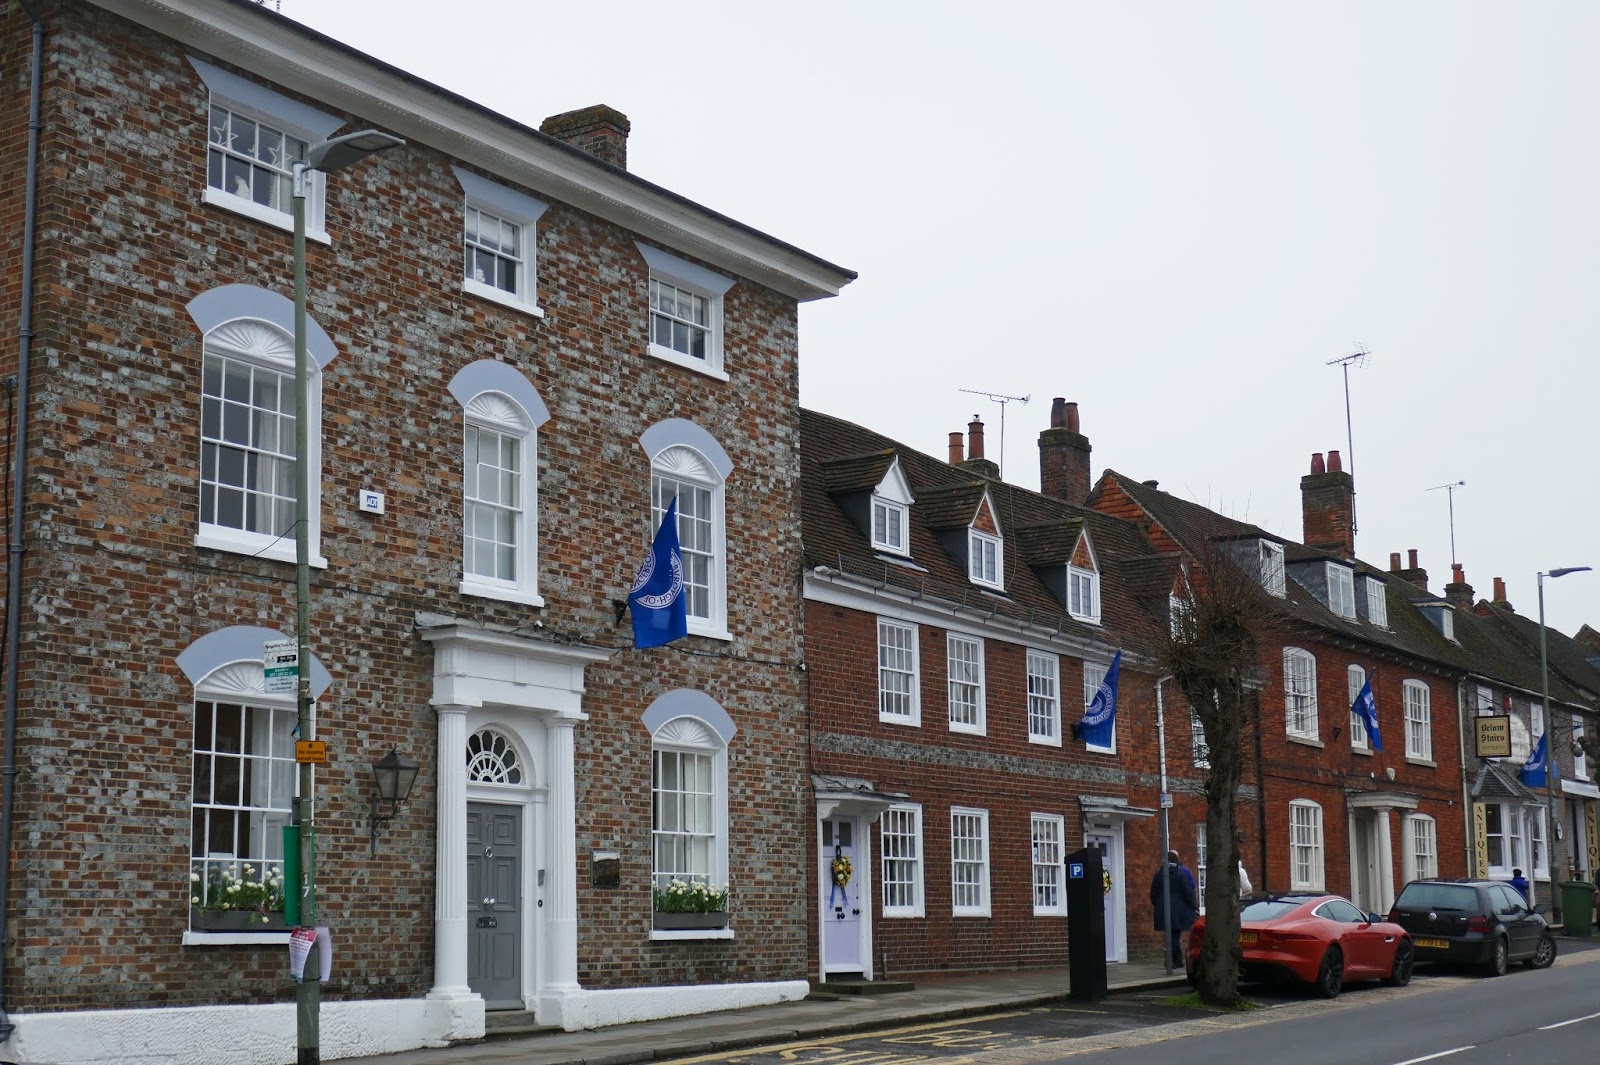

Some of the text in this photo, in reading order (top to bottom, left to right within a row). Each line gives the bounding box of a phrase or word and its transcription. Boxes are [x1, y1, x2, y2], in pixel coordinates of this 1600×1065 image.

[1481, 724, 1504, 732] Below
[1481, 734, 1505, 742] Stairs
[1476, 805, 1486, 876] ANTIQUES
[1588, 806, 1598, 883] ANTIQUE
[1073, 865, 1081, 876] P
